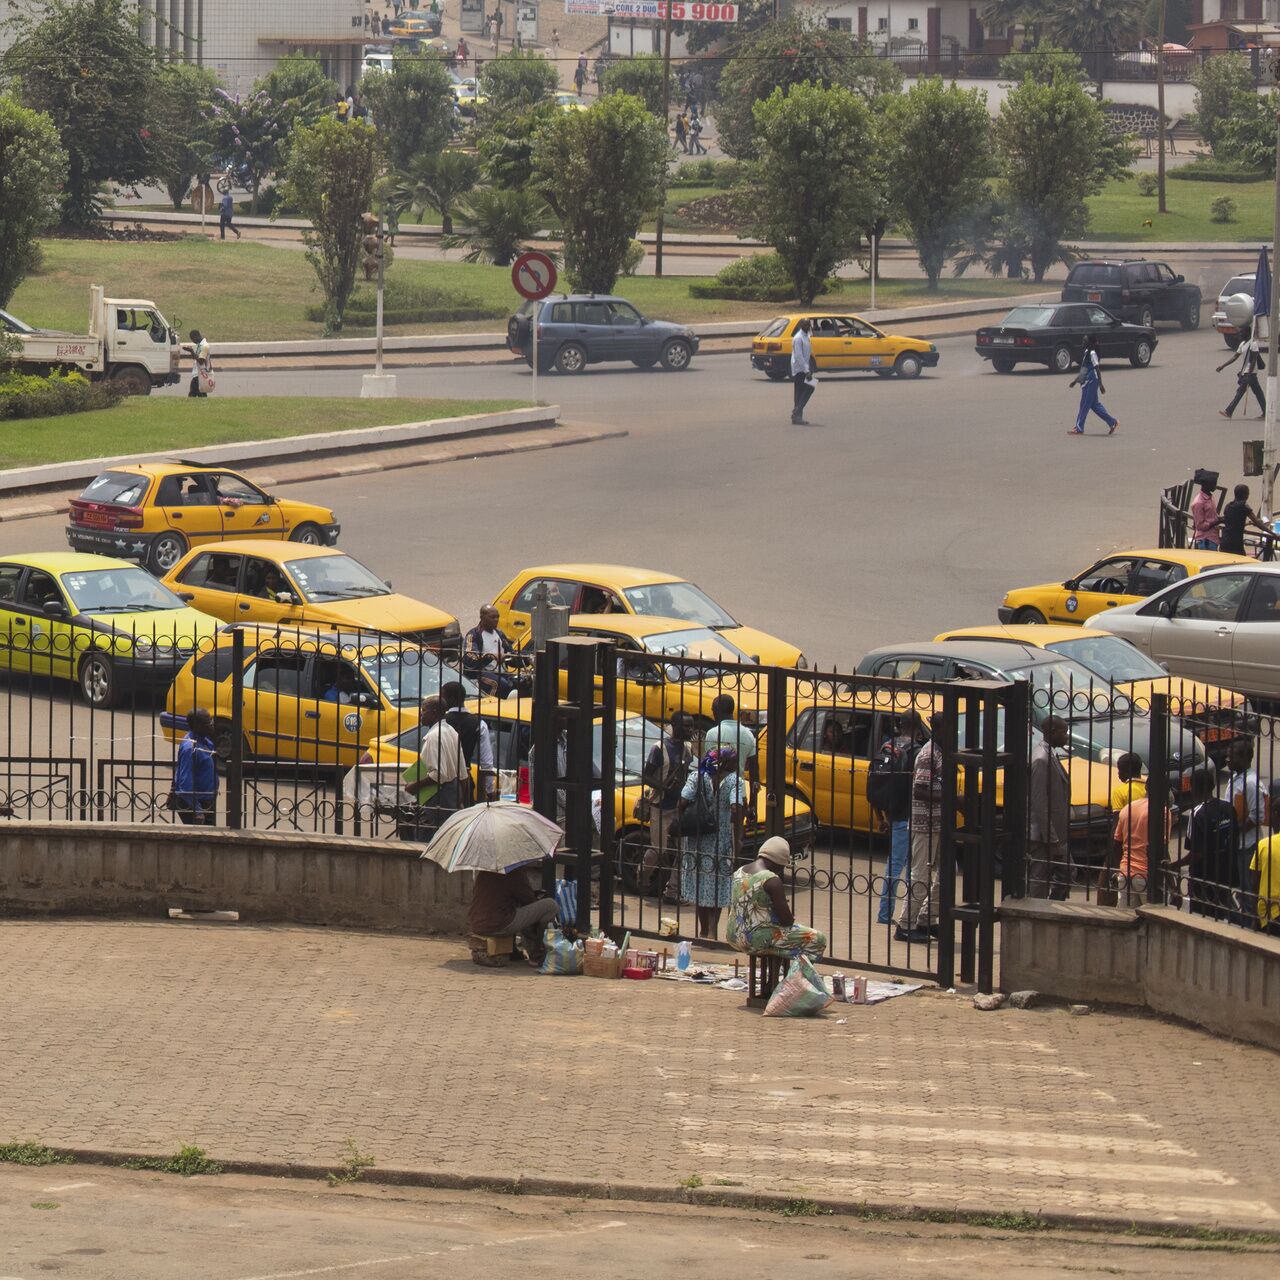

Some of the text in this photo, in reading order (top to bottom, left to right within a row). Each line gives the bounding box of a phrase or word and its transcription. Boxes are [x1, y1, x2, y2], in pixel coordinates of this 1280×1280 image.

[615, 4, 634, 12] CORE
[636, 4, 641, 12] 2
[642, 5, 656, 13] DUO
[691, 2, 735, 21] 900
